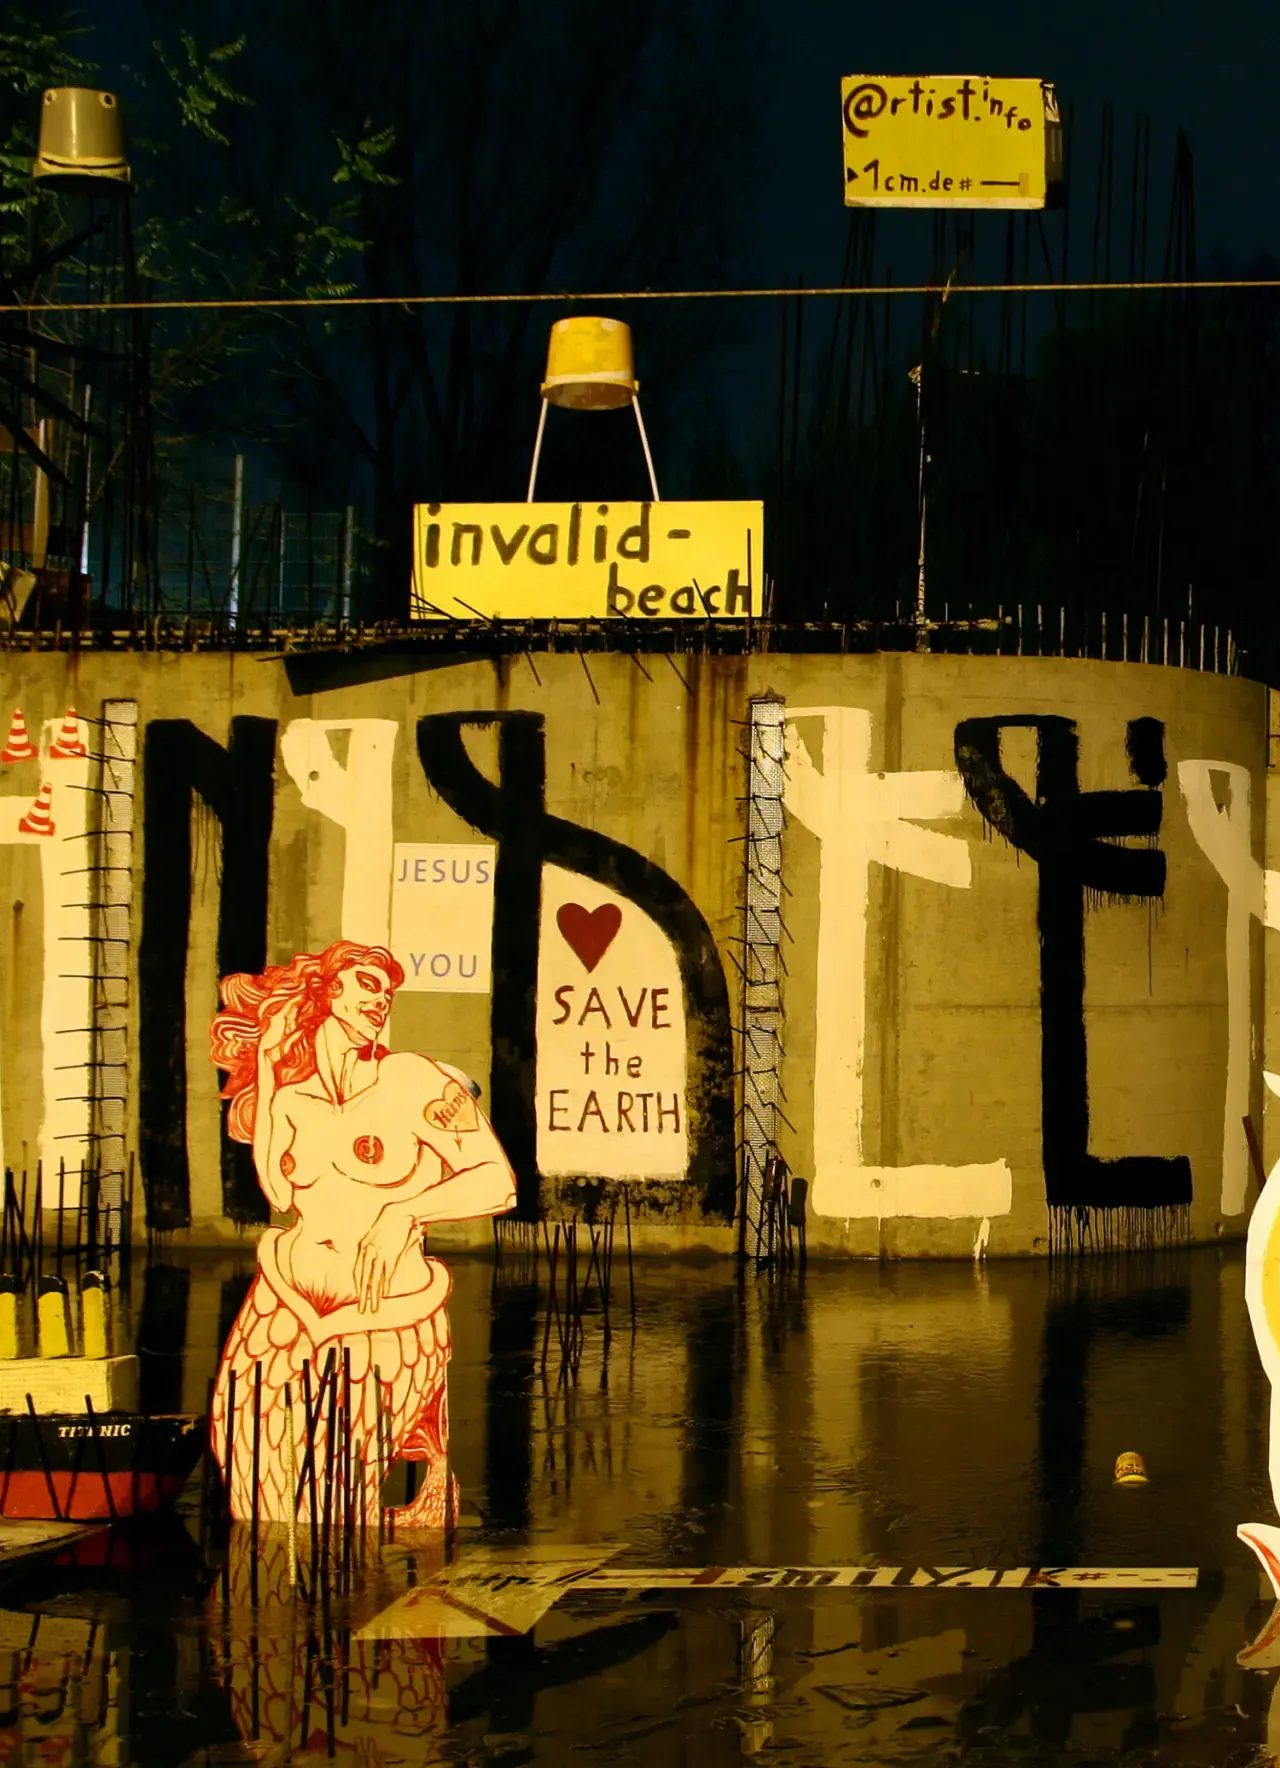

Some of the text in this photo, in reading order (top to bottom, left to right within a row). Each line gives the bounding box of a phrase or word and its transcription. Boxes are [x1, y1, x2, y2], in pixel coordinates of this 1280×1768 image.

[607, 562, 750, 616] beach
[398, 859, 491, 884] JESUS
[410, 953, 478, 978] YOU
[552, 985, 672, 1030] SAVE
[580, 1041, 643, 1079] the
[548, 1089, 681, 1134] EARTH
